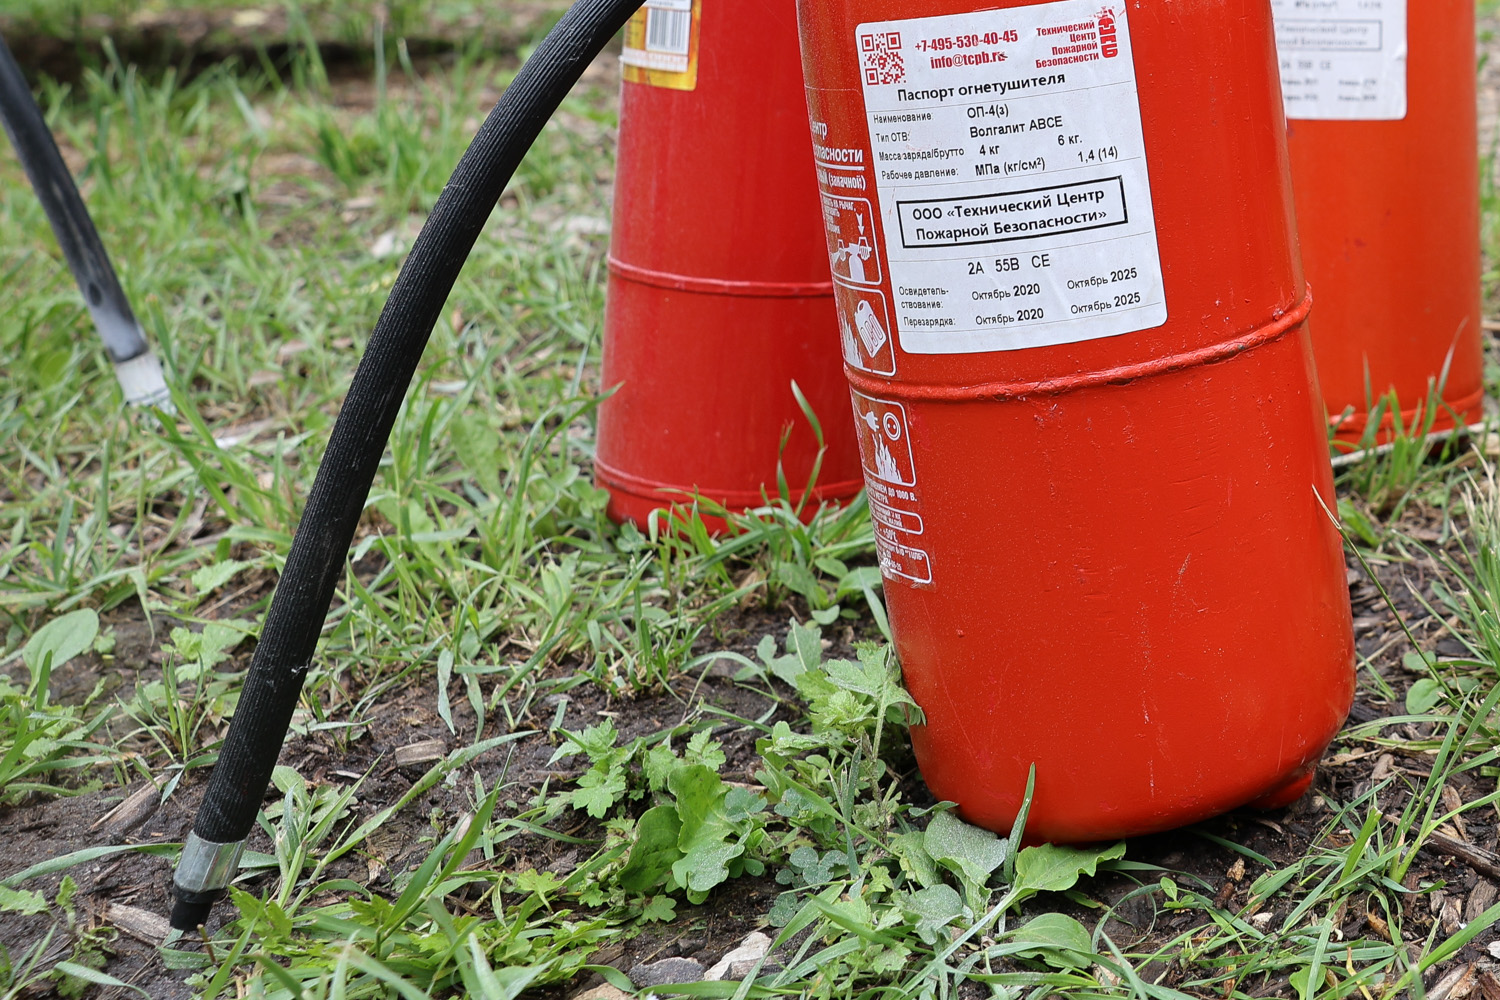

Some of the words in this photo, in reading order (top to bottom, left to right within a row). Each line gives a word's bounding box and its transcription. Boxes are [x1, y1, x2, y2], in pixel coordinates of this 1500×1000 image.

[1036, 20, 1095, 37] Технический
[1069, 31, 1097, 43] Центр
[915, 29, 1018, 52] +7-495-530-40-45
[1052, 41, 1098, 56] Пожарной
[1035, 52, 1099, 68] Безопасности
[898, 88, 955, 101] Паспорт
[958, 74, 1065, 95] огнетушителя
[873, 112, 933, 124] Наименование:
[967, 104, 1009, 119] ОП-4(з)
[876, 132, 889, 143] Тип
[969, 123, 1025, 138] Волгалит
[878, 151, 902, 162] Масса
[902, 147, 964, 163] заряда/брутто
[979, 145, 986, 156] 4
[989, 145, 999, 155] кг
[1057, 134, 1065, 146] 6
[1068, 134, 1082, 145] кг.
[881, 169, 912, 181] Рабочее
[914, 167, 958, 181] давление:
[975, 163, 1000, 177] МПа
[1078, 149, 1095, 163] 1,4
[1098, 146, 1118, 162] (14)
[912, 207, 943, 220] ООО
[946, 194, 1052, 218] «Технический
[1056, 190, 1104, 208] Центр
[916, 223, 989, 242] Пожарной
[993, 211, 1107, 234] Безопасности»
[967, 261, 984, 275] 2A
[995, 257, 1020, 272] 55B
[899, 286, 949, 297] Освидетель-
[971, 289, 1011, 301] Октябрь
[1013, 283, 1041, 297] 2020
[1067, 276, 1108, 291] Октябрь
[1110, 267, 1138, 282] 2025
[901, 301, 944, 309] ствование:
[903, 316, 956, 328] Перезарядка:
[975, 313, 1015, 326] Октябрь
[1016, 307, 1044, 321] 2020
[1070, 301, 1112, 314] Октябрь
[1114, 292, 1141, 307] 2025
